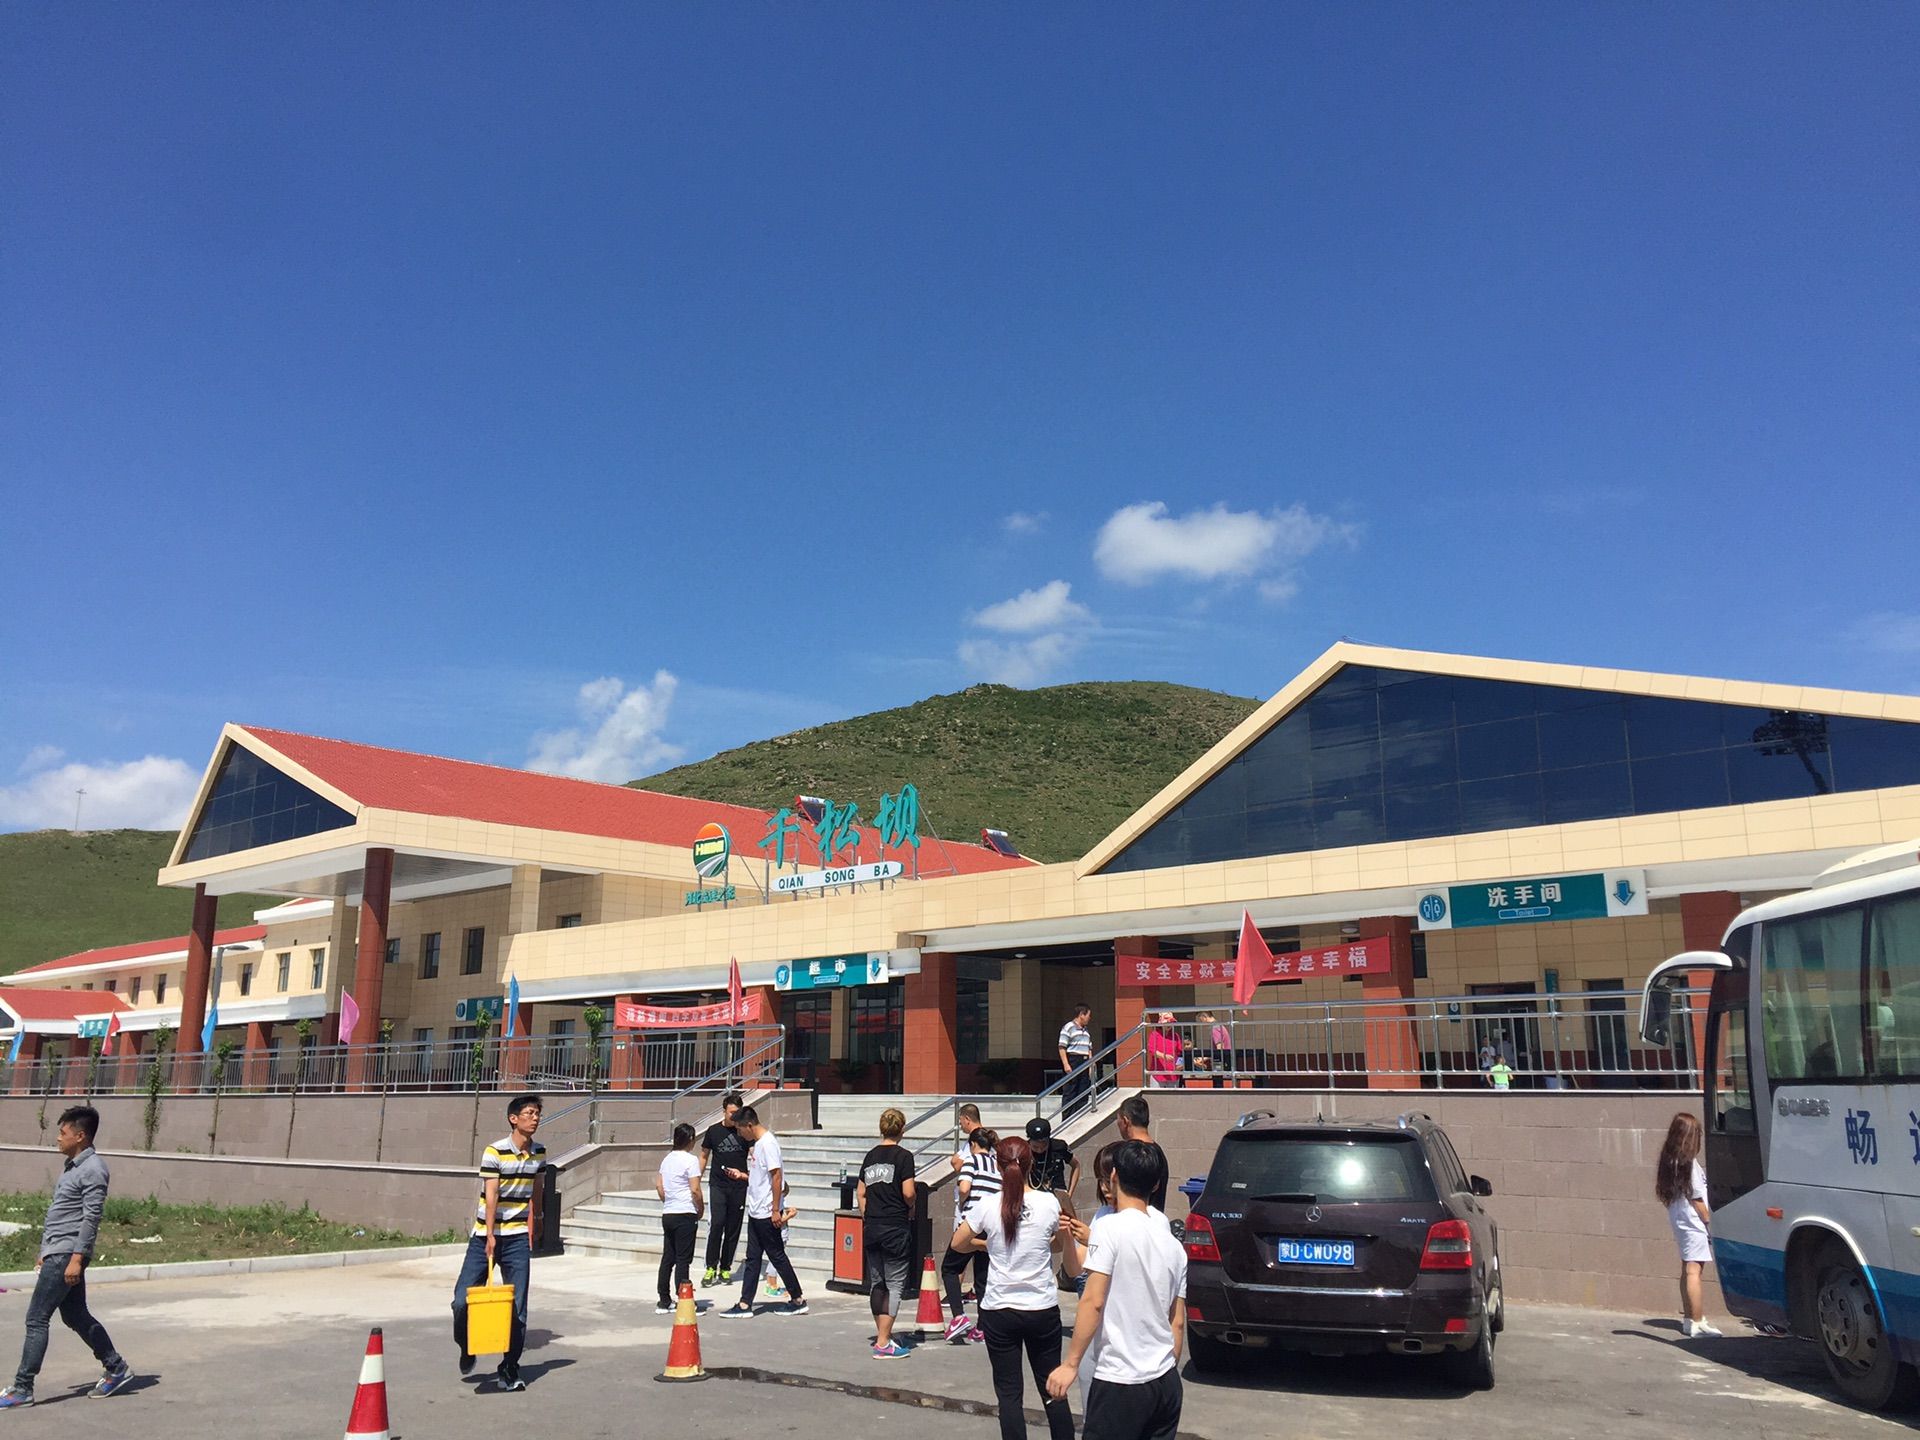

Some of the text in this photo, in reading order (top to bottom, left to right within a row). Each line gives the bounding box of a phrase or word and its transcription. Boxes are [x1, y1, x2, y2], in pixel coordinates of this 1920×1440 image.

[778, 864, 890, 890] QIAN SONG BA
[1487, 882, 1562, 907] 洗手间
